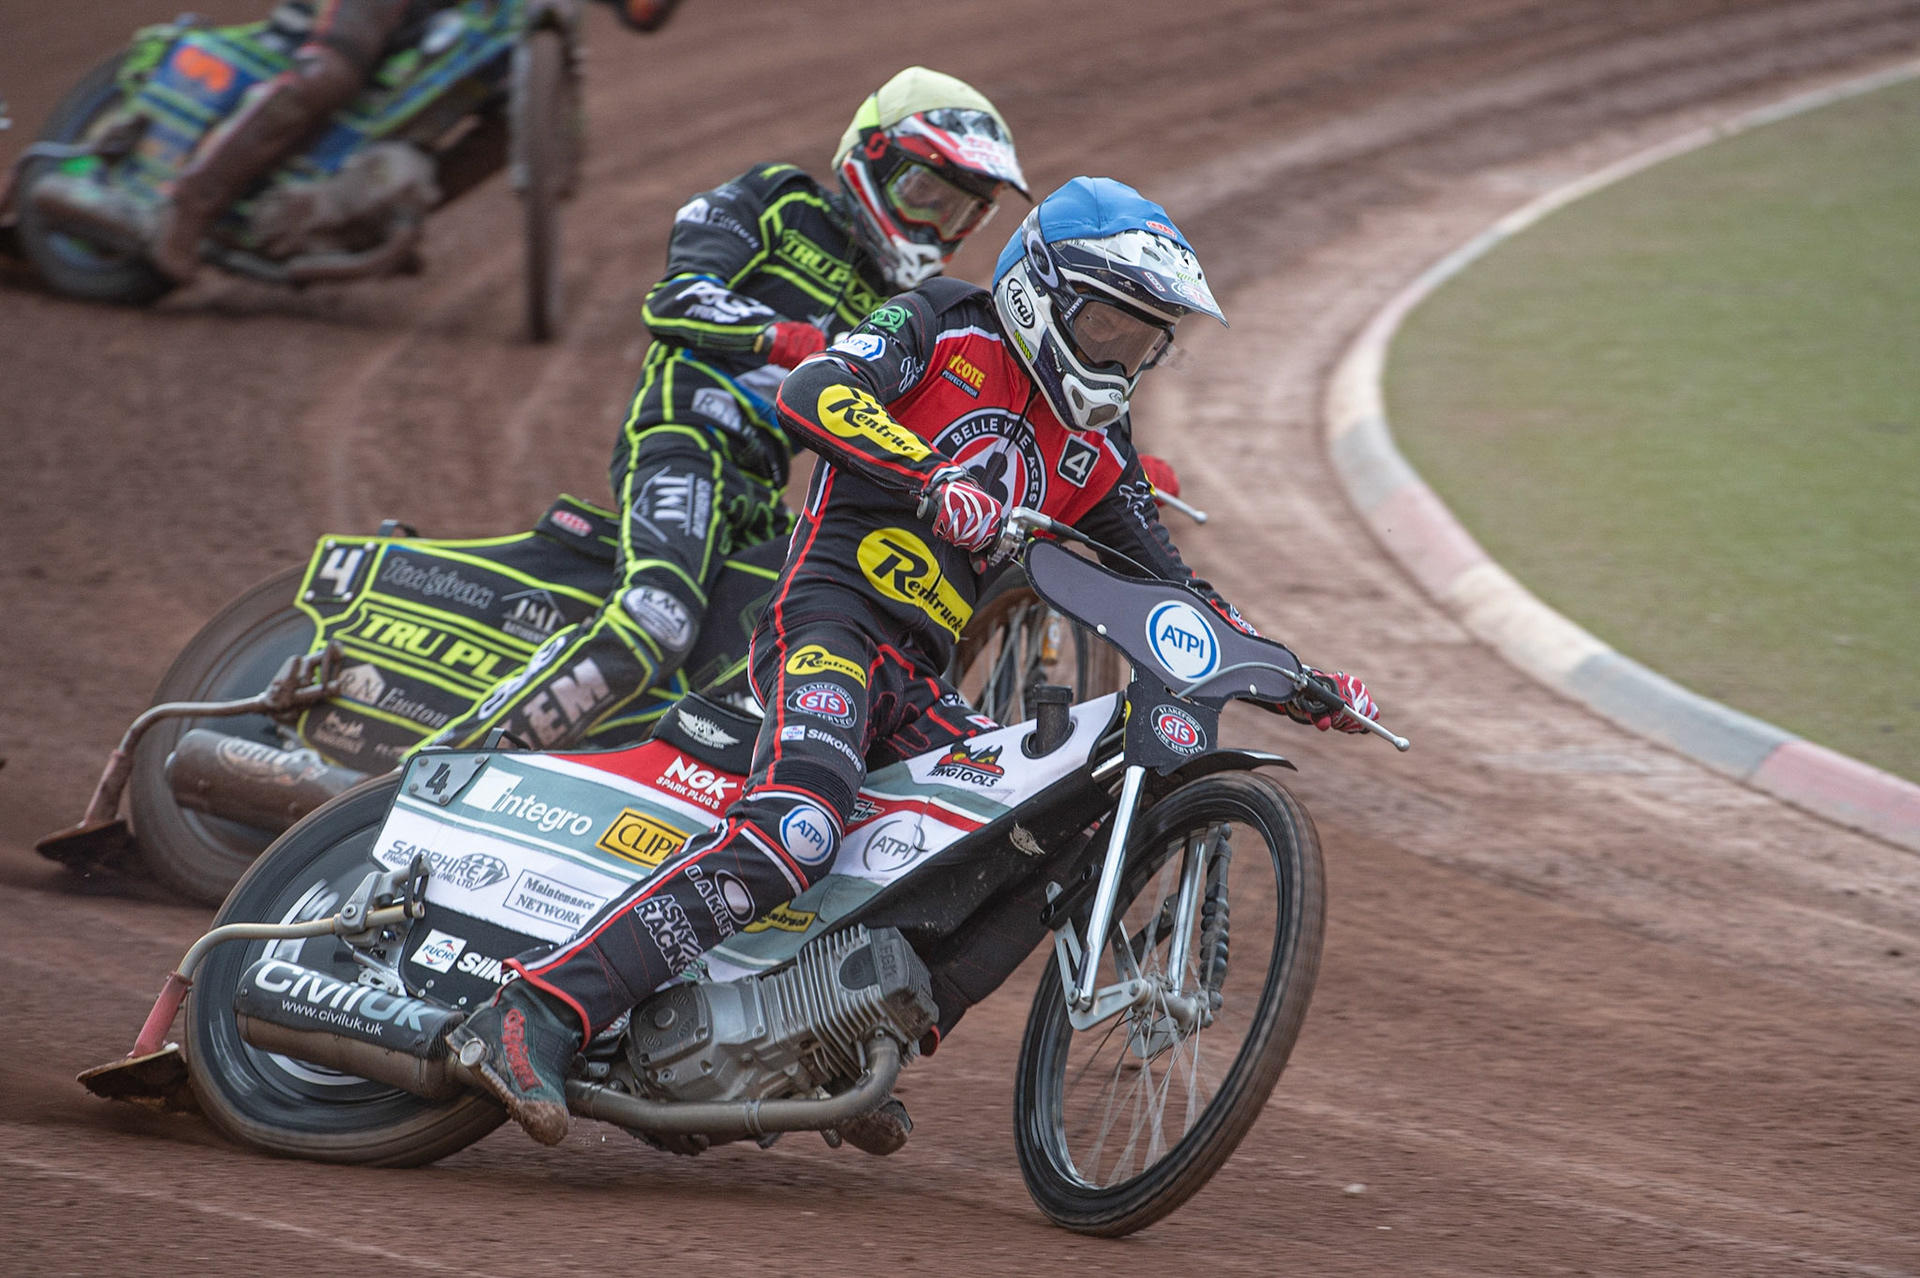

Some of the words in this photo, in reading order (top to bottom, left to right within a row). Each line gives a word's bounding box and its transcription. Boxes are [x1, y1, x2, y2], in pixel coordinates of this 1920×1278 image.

[1009, 283, 1034, 322] Arai
[826, 389, 926, 452] Rentruc
[950, 417, 999, 447] BELLE
[1027, 456, 1039, 503] ACES
[1066, 450, 1089, 479] 4
[319, 548, 365, 596] 4
[872, 537, 963, 632] Rentruck
[359, 612, 447, 657] TRU
[1160, 624, 1205, 659] ATPI
[805, 691, 841, 712] STS
[1163, 717, 1190, 743] STS
[806, 728, 863, 772] Silkolene
[425, 762, 451, 795] 4
[655, 775, 688, 796] SPARK
[686, 788, 721, 810] PLUGS
[663, 755, 738, 801] NGK
[491, 788, 593, 837] integro
[790, 818, 826, 851] ATPI
[872, 835, 913, 861] ATPI
[515, 894, 585, 926] NETWORK
[522, 876, 597, 911] Maintenance
[422, 943, 457, 961] FUCHS
[281, 999, 384, 1037] www.civiluk.uk
